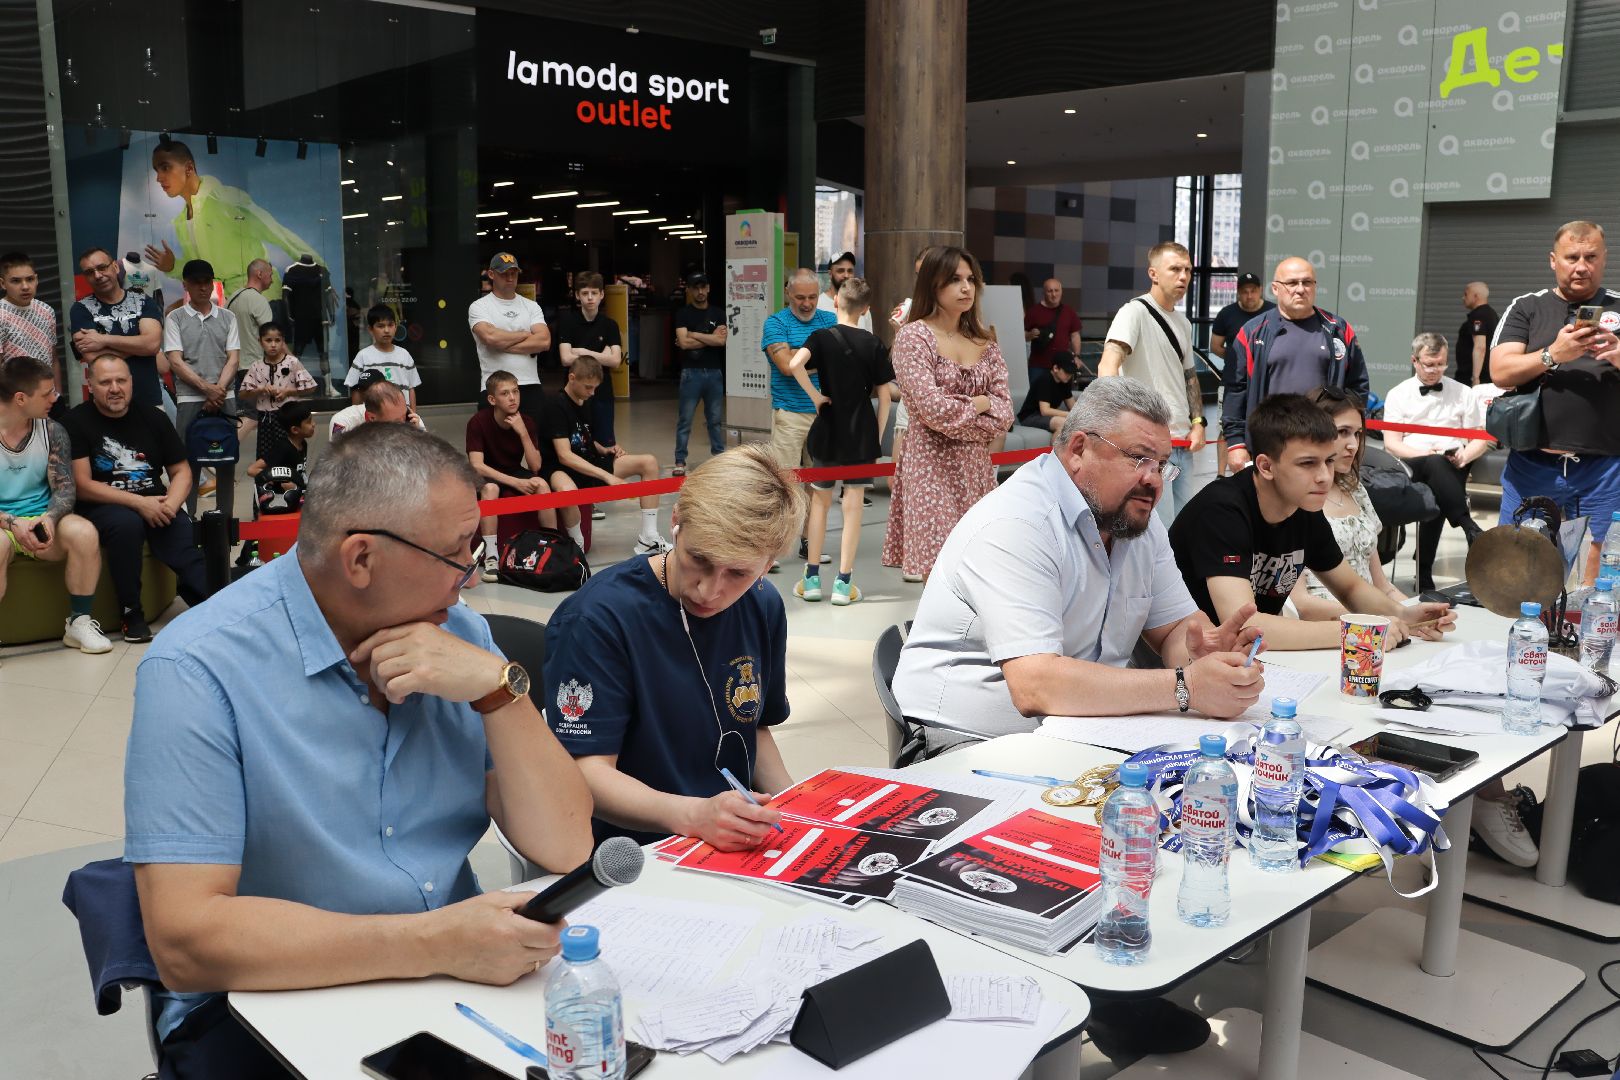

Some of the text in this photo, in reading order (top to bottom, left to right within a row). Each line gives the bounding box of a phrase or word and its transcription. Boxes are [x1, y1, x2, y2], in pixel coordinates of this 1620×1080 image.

[507, 50, 729, 104] lamoda sport
[1440, 26, 1563, 98] Де
[577, 100, 671, 130] outlet
[272, 467, 291, 477] TITLE
[1182, 813, 1226, 829] СТОЧНИК
[948, 850, 1072, 892] ПУШКИНСКАЯ
